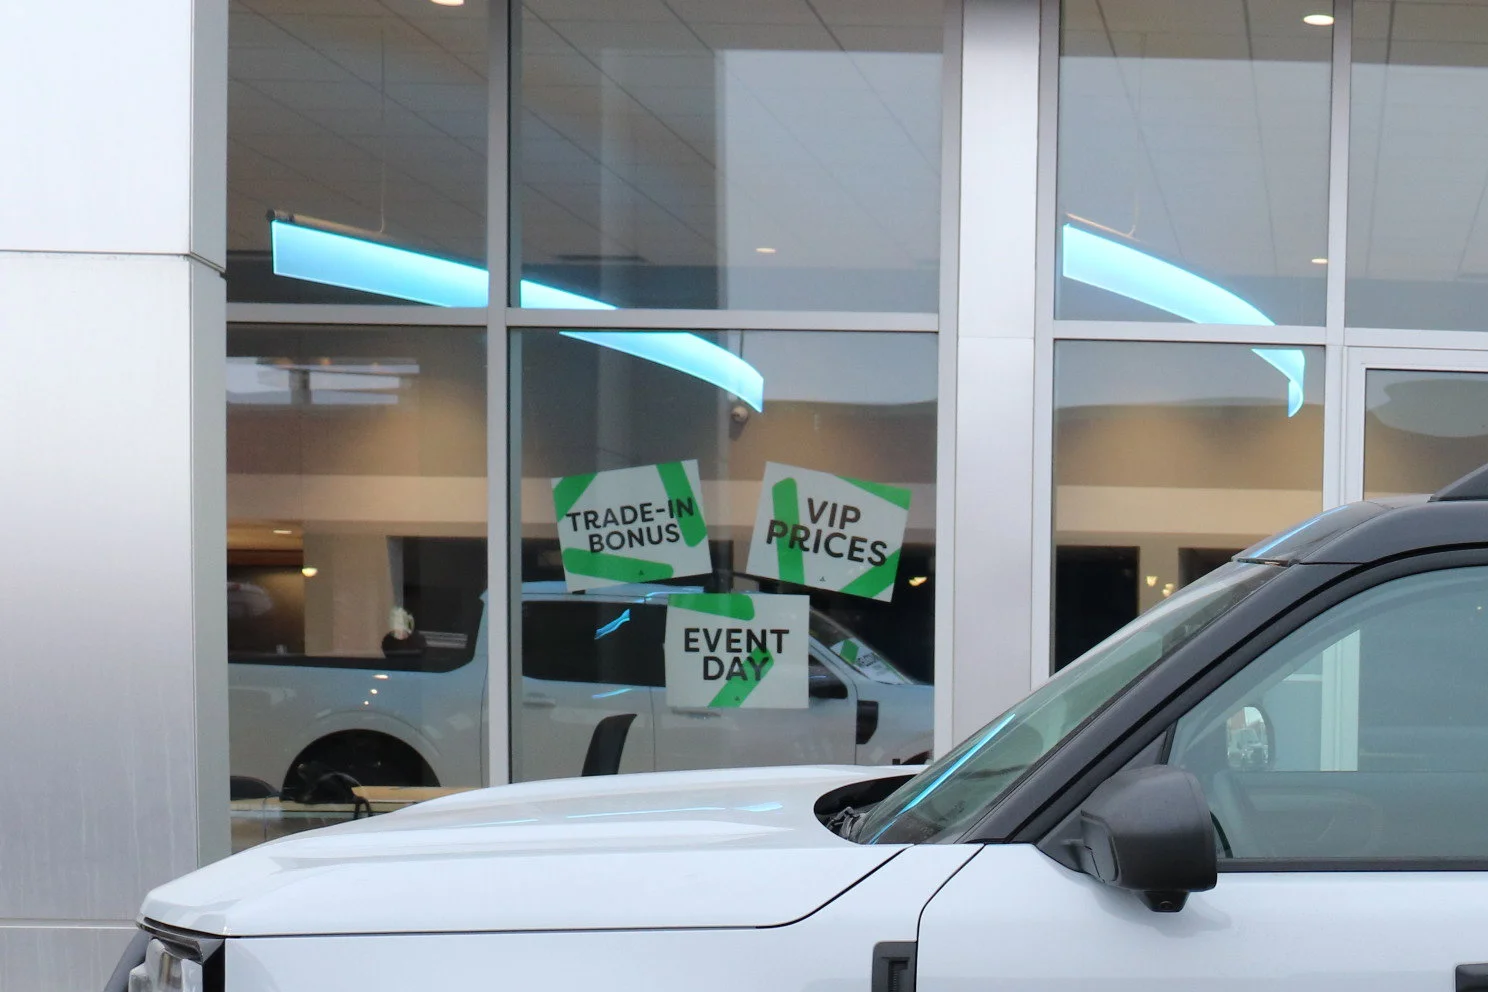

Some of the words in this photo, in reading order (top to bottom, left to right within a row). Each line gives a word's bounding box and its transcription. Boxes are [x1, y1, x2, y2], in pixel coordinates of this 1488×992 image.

[565, 497, 694, 532] TRADE-IN
[807, 497, 861, 530] VIP
[588, 523, 680, 553] BONUS
[766, 519, 888, 567] PRICES
[684, 627, 790, 654] EVENT
[703, 655, 770, 681] DAY
